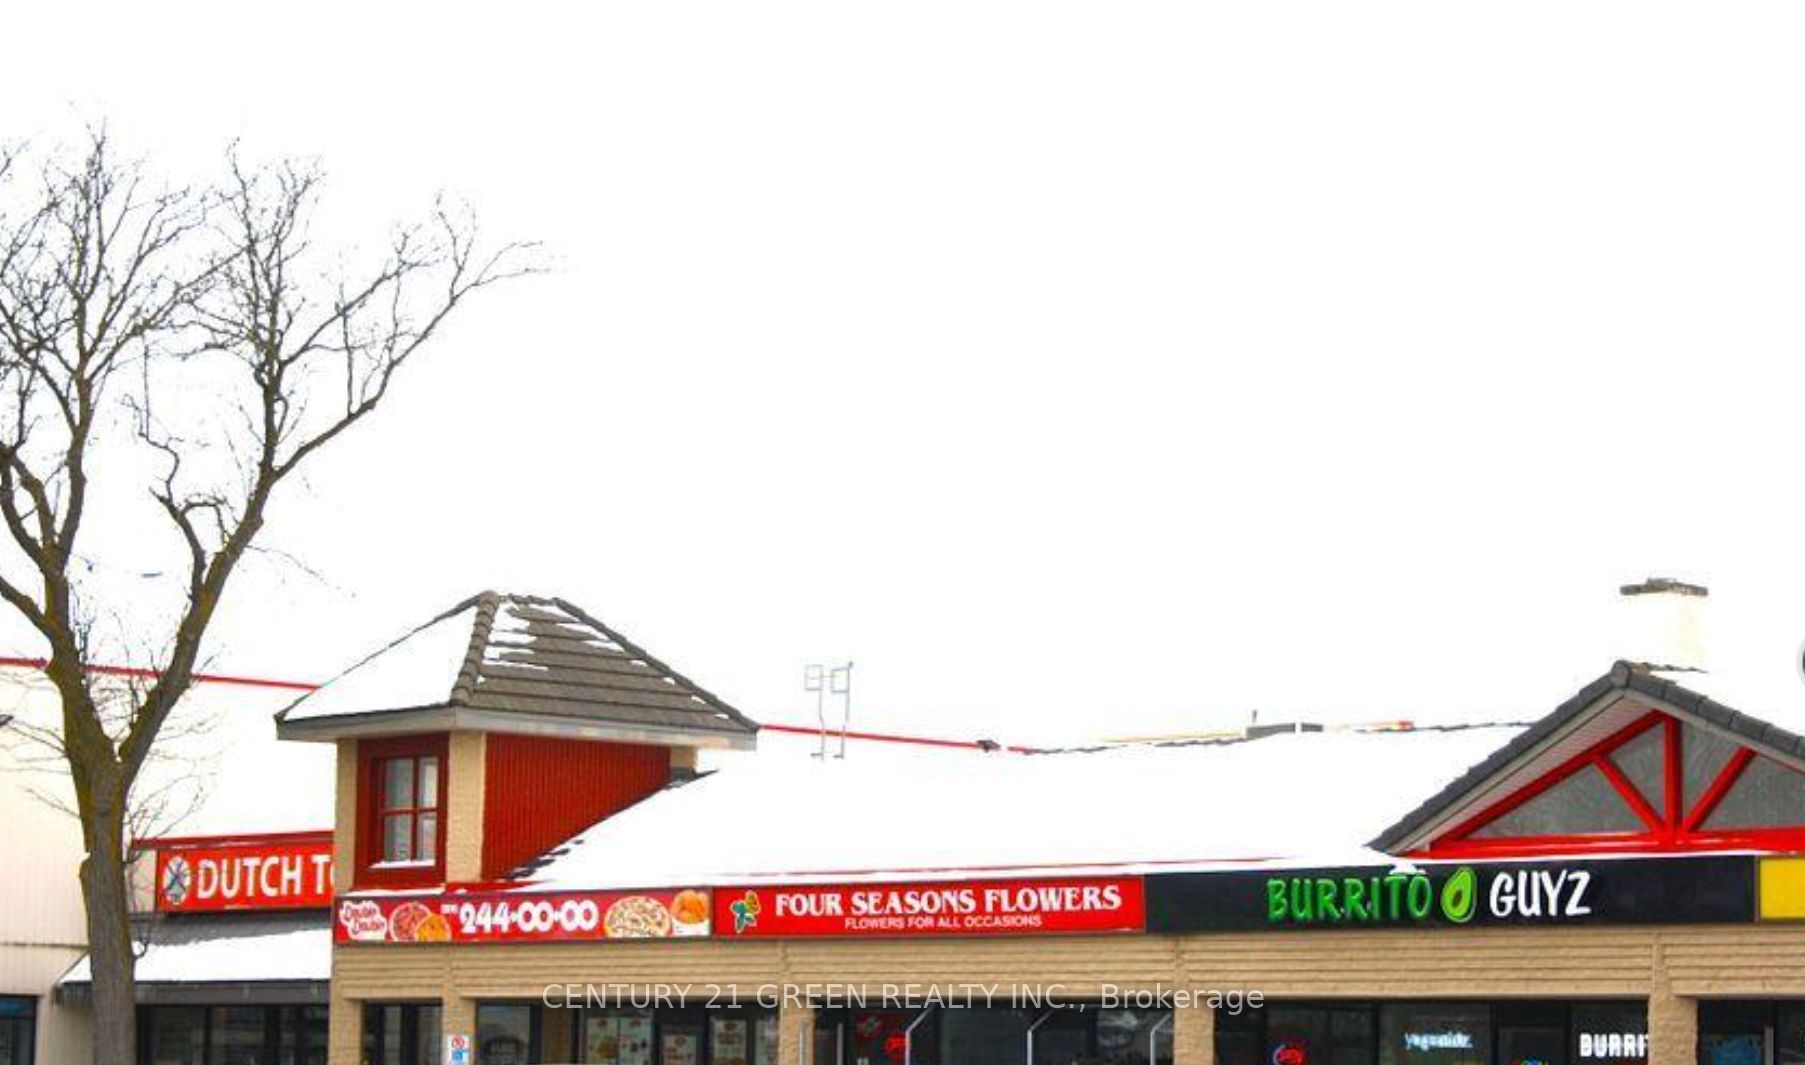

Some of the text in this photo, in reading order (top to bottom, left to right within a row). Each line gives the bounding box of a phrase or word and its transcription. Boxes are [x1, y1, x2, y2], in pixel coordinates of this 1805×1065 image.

[197, 854, 334, 899] DUTCH T
[775, 885, 1122, 916] FOUR SEASONS FLOWERS
[1266, 869, 1592, 921] BURRITO GUYZ
[459, 899, 599, 933] 244-00-00
[845, 914, 1041, 929] FLOWERS FOR ALL OCCASIONS
